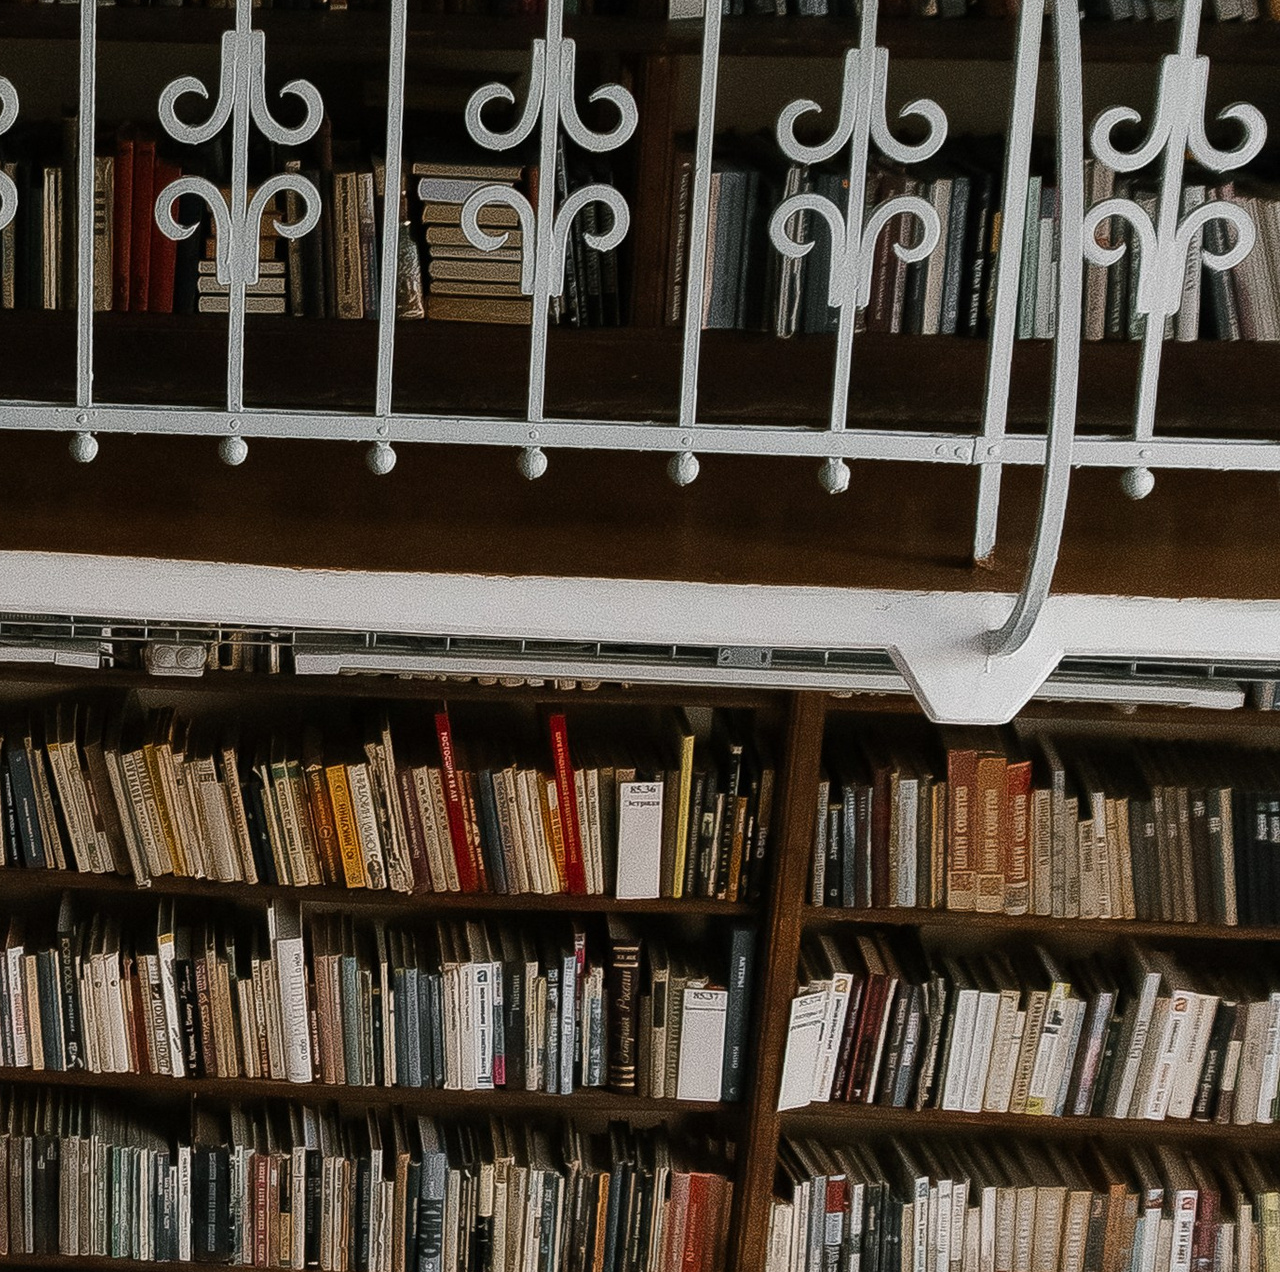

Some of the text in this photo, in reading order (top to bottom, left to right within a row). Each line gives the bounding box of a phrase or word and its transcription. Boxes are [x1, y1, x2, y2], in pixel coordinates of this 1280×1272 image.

[354, 771, 371, 820] НИКУЛИН
[629, 785, 656, 794] 85.36
[338, 803, 352, 846] НИКУЛИН
[954, 785, 968, 869] ШАГИ СОВЕТОВ
[1011, 794, 1027, 880] ШАГИ СОВЕТОВ
[617, 968, 633, 1013] России
[419, 1199, 443, 1258] КИНО
